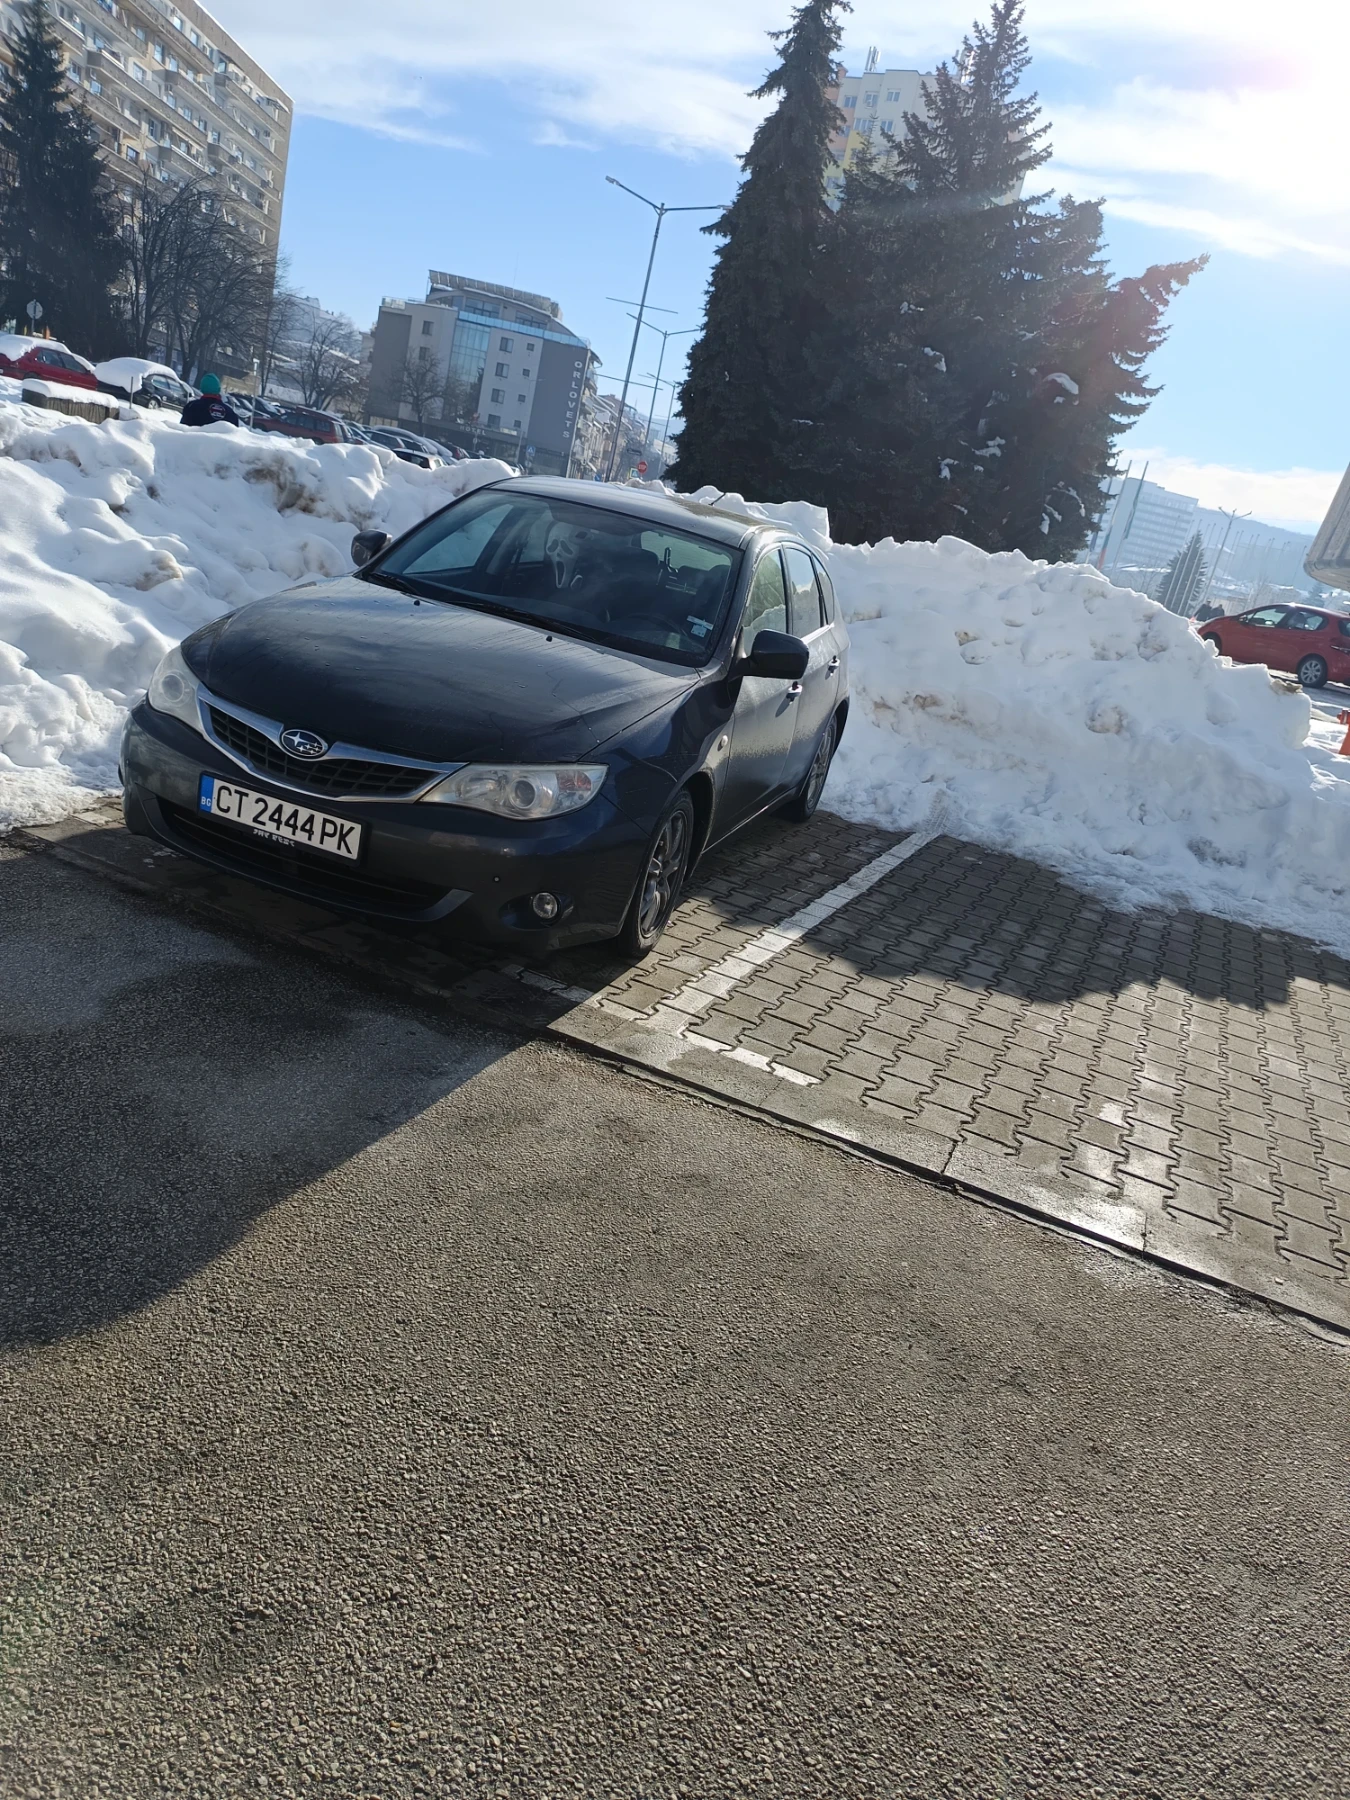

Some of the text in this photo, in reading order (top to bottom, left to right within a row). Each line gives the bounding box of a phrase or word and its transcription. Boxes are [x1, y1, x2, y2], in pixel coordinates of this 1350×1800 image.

[563, 361, 582, 438] ORLOVETS
[459, 425, 486, 436] HOTEL
[200, 796, 212, 807] BG
[216, 785, 249, 818] CT
[252, 797, 315, 841] 2444
[320, 817, 355, 854] PK
